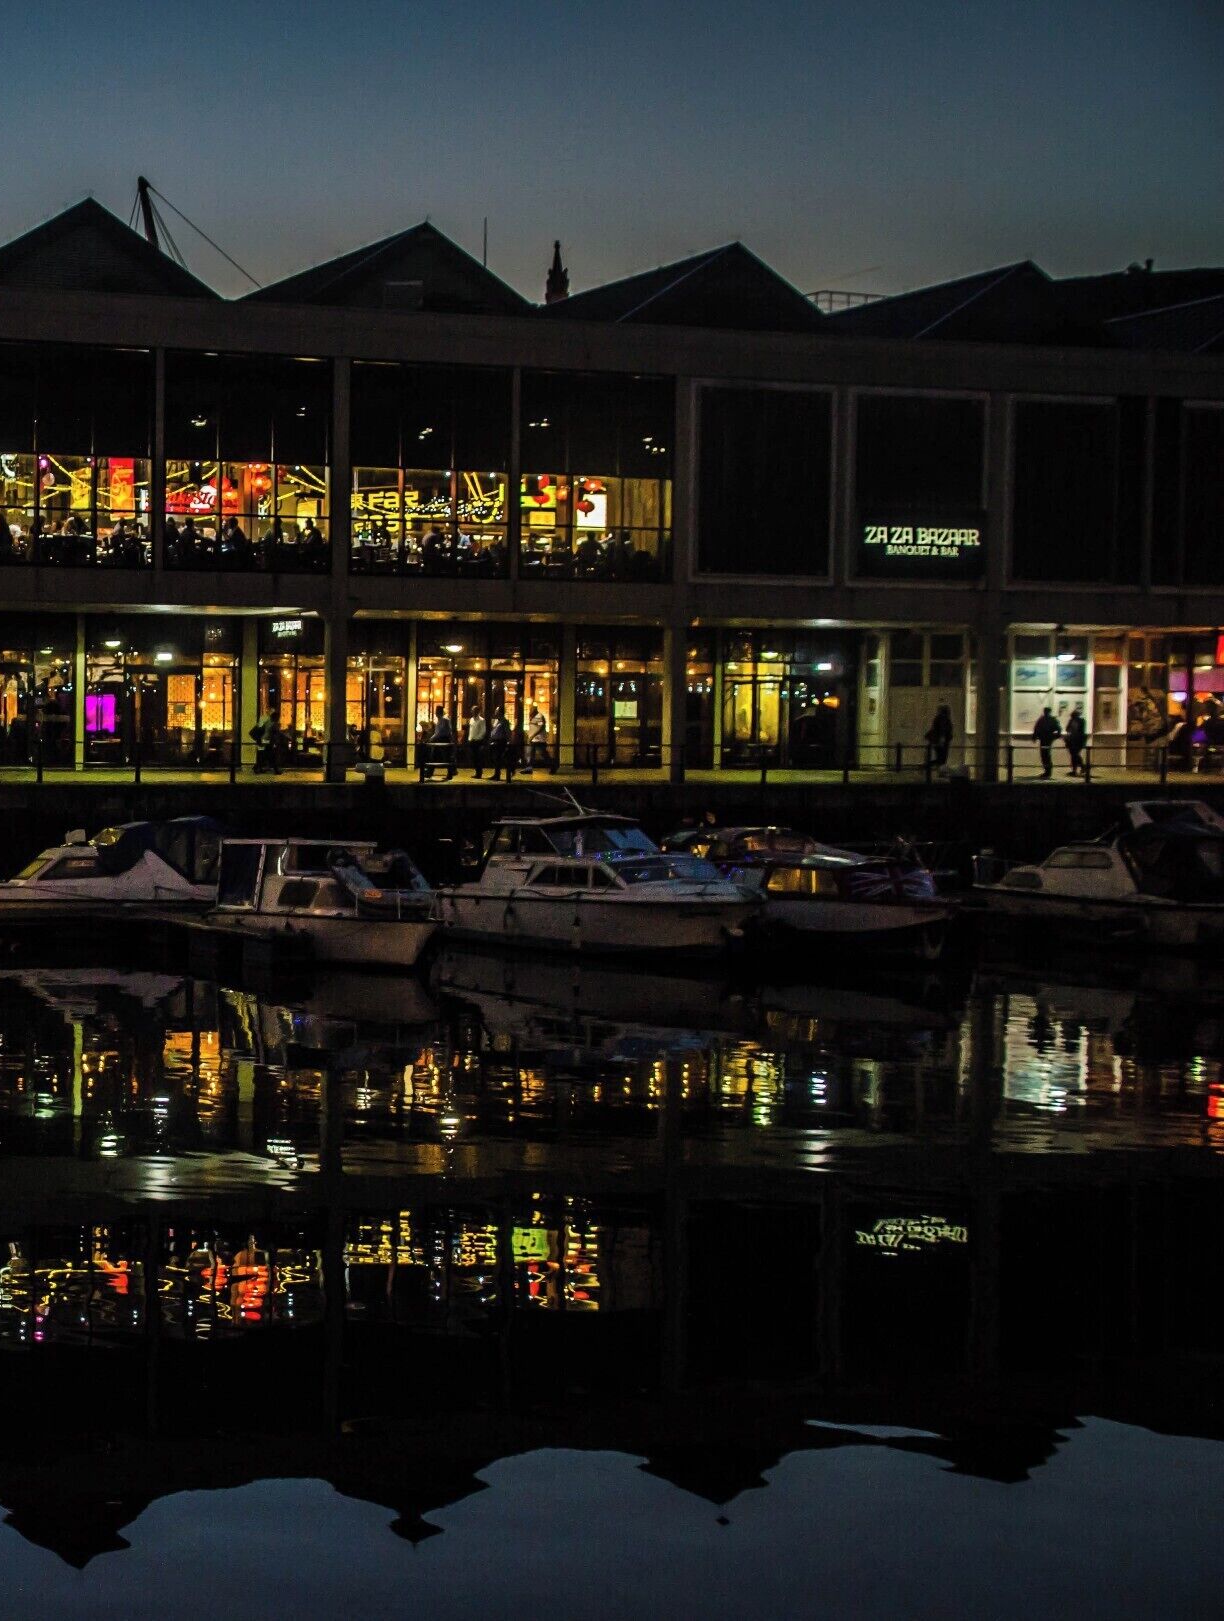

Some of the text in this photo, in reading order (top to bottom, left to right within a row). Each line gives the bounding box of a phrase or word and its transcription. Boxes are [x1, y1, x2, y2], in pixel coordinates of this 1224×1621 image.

[864, 526, 981, 546] ZA ZA BAZAAR
[885, 545, 959, 557] BANQUET & BAR
